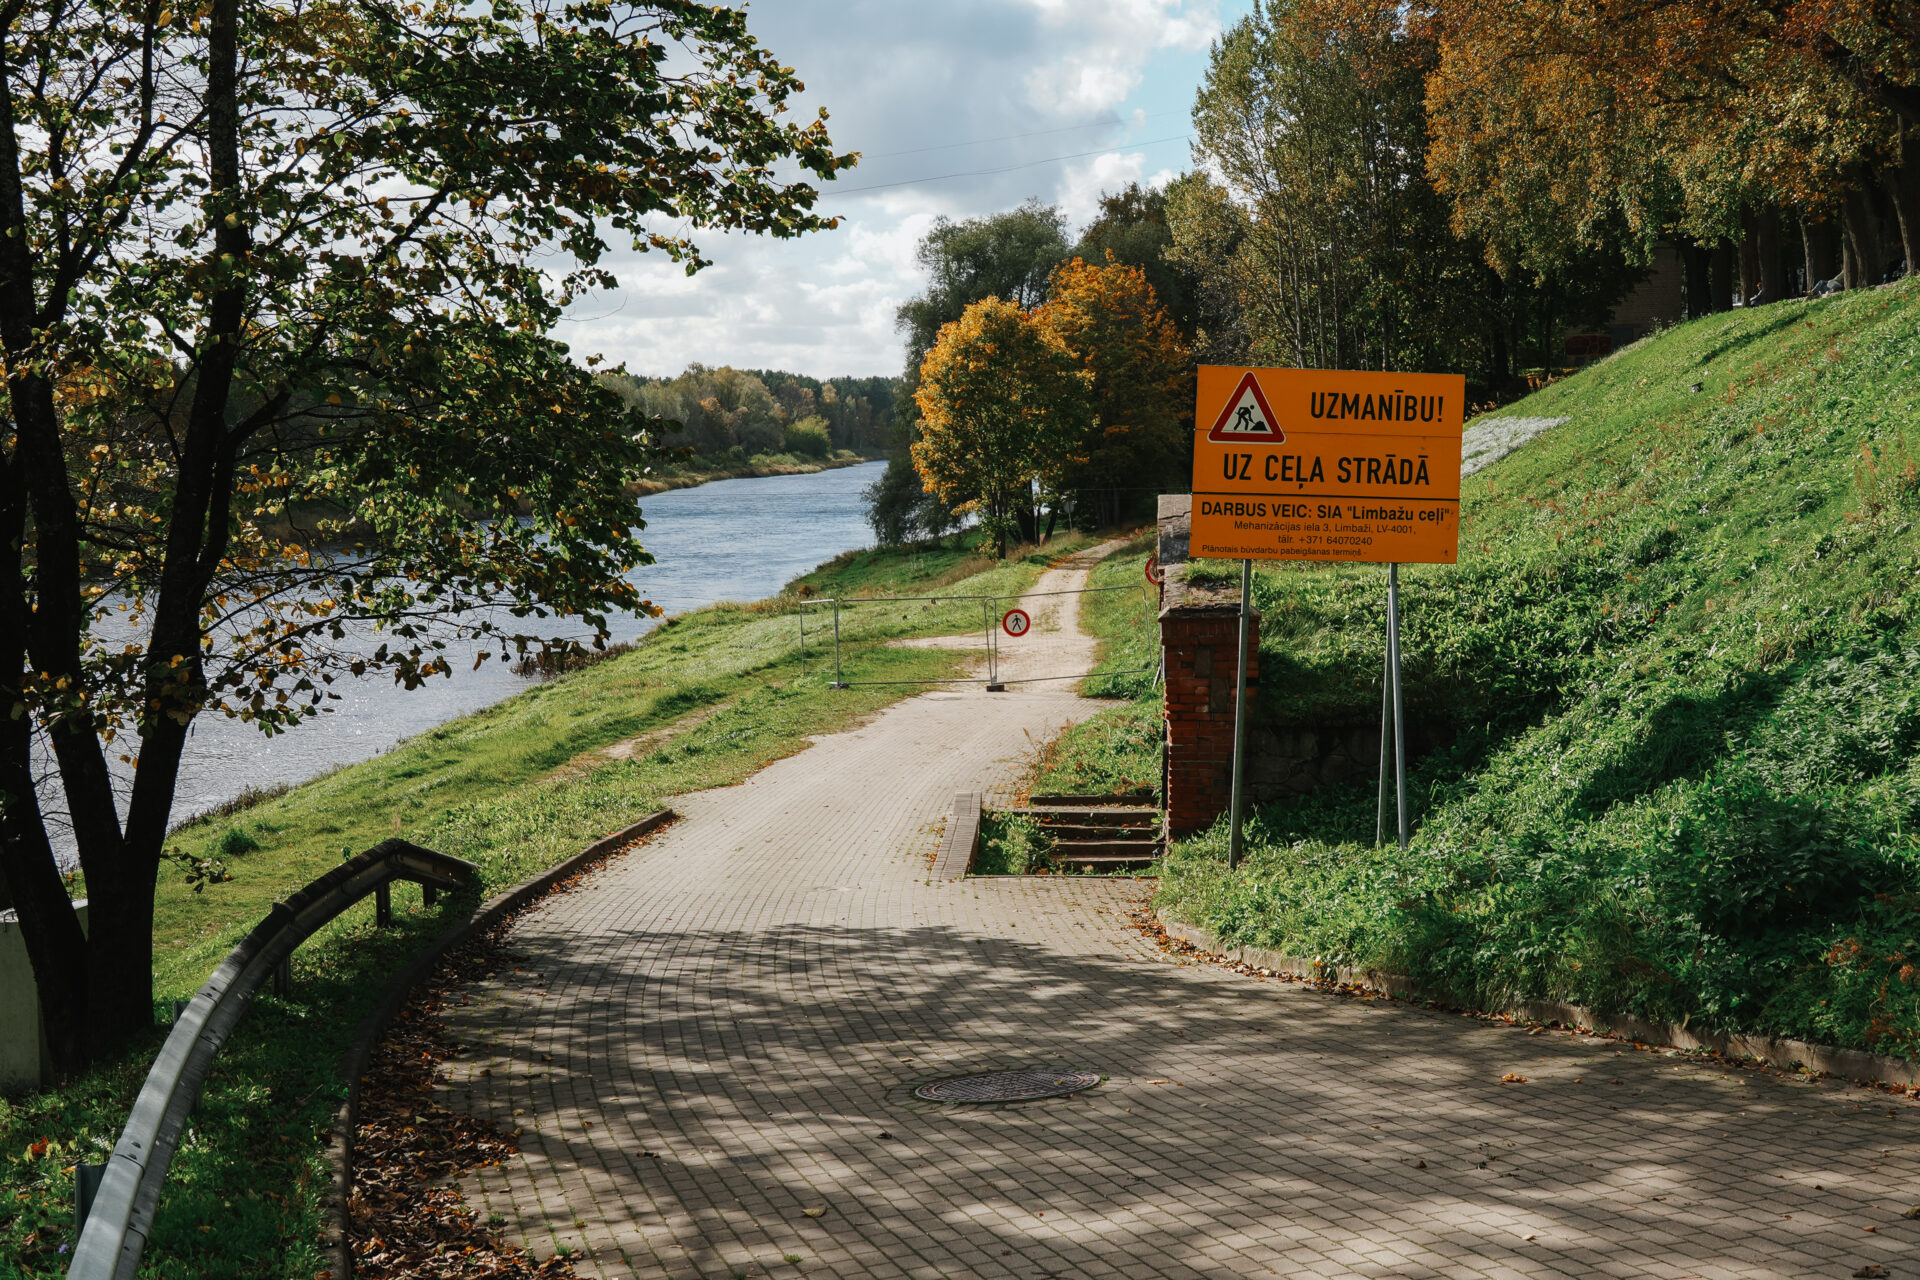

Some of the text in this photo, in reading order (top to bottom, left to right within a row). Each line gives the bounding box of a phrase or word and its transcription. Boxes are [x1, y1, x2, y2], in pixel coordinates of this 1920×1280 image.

[1310, 390, 1443, 423] UZMANĪBU!
[1223, 453, 1430, 489] UZ CEĻA STRĀDĀ
[1201, 502, 1449, 525] DARBUS VEIC: SIA "Limbažu ceļi"
[1234, 521, 1301, 532] Mehanizācijas
[1304, 523, 1322, 532] iela
[1377, 525, 1416, 535] LV-4001,
[1299, 536, 1322, 544] +371
[1327, 537, 1372, 545] 64070240
[1202, 545, 1238, 553] Plānotais
[1240, 546, 1278, 554] būvdarbu
[1280, 547, 1330, 556] pabeigšanas
